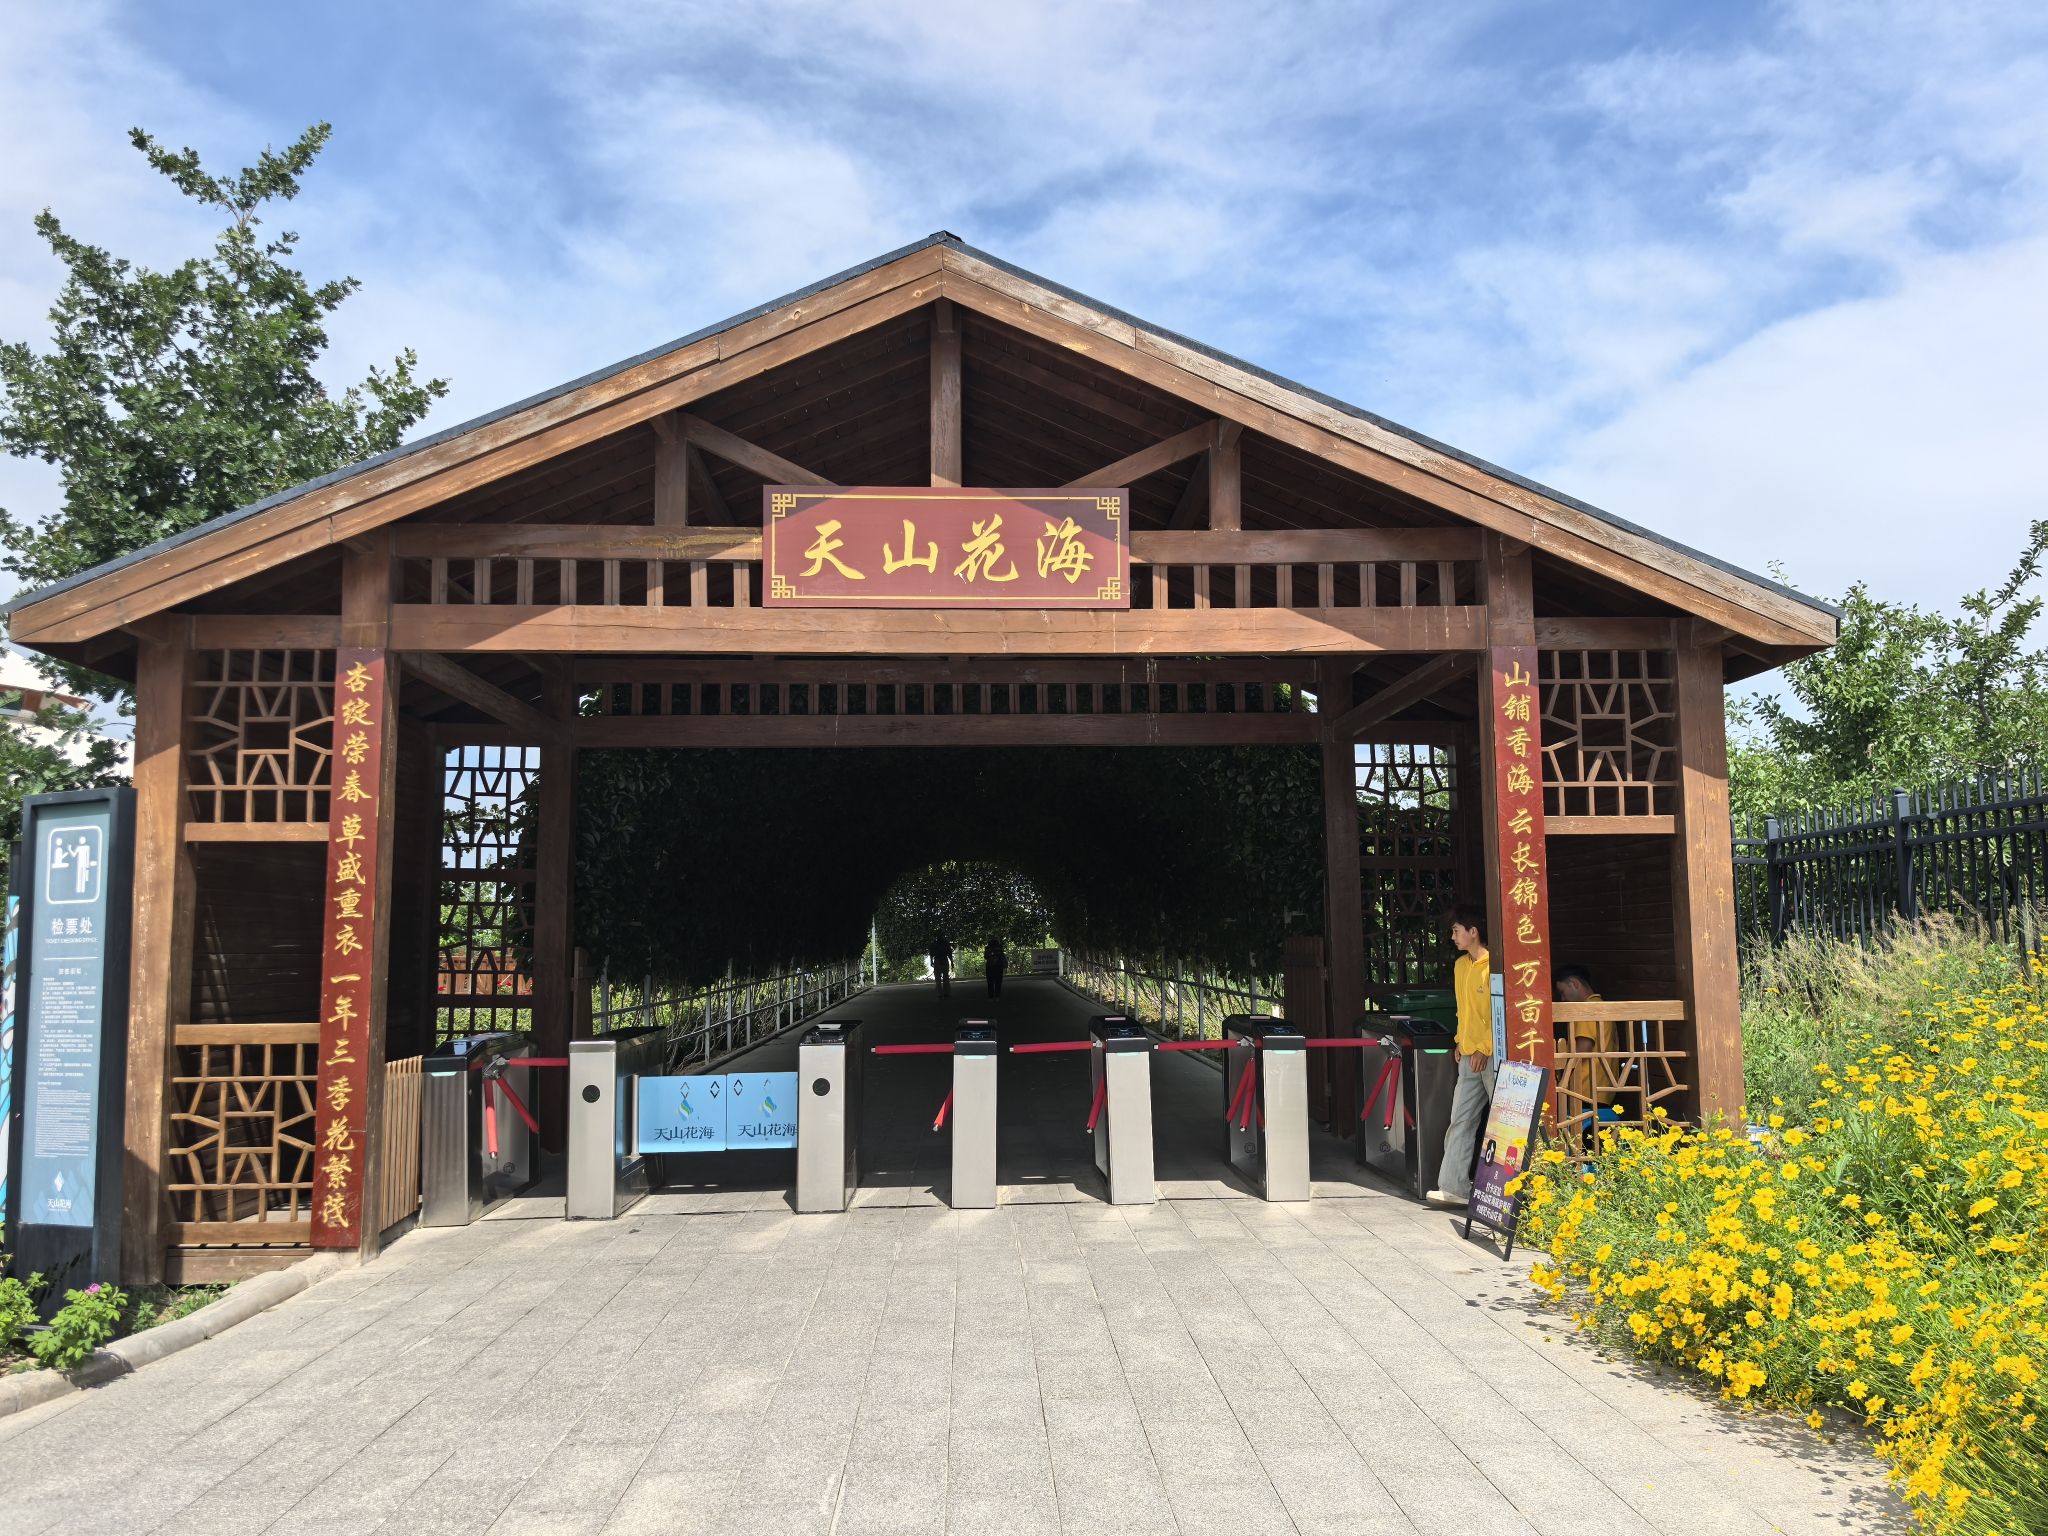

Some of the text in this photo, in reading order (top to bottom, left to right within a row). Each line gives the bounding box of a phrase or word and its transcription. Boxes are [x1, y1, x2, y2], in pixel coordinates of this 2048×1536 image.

[799, 512, 1095, 585] 天山花海
[52, 917, 92, 935] 检票处
[654, 1126, 715, 1141] 天山花海
[738, 1122, 798, 1138] 天山花海
